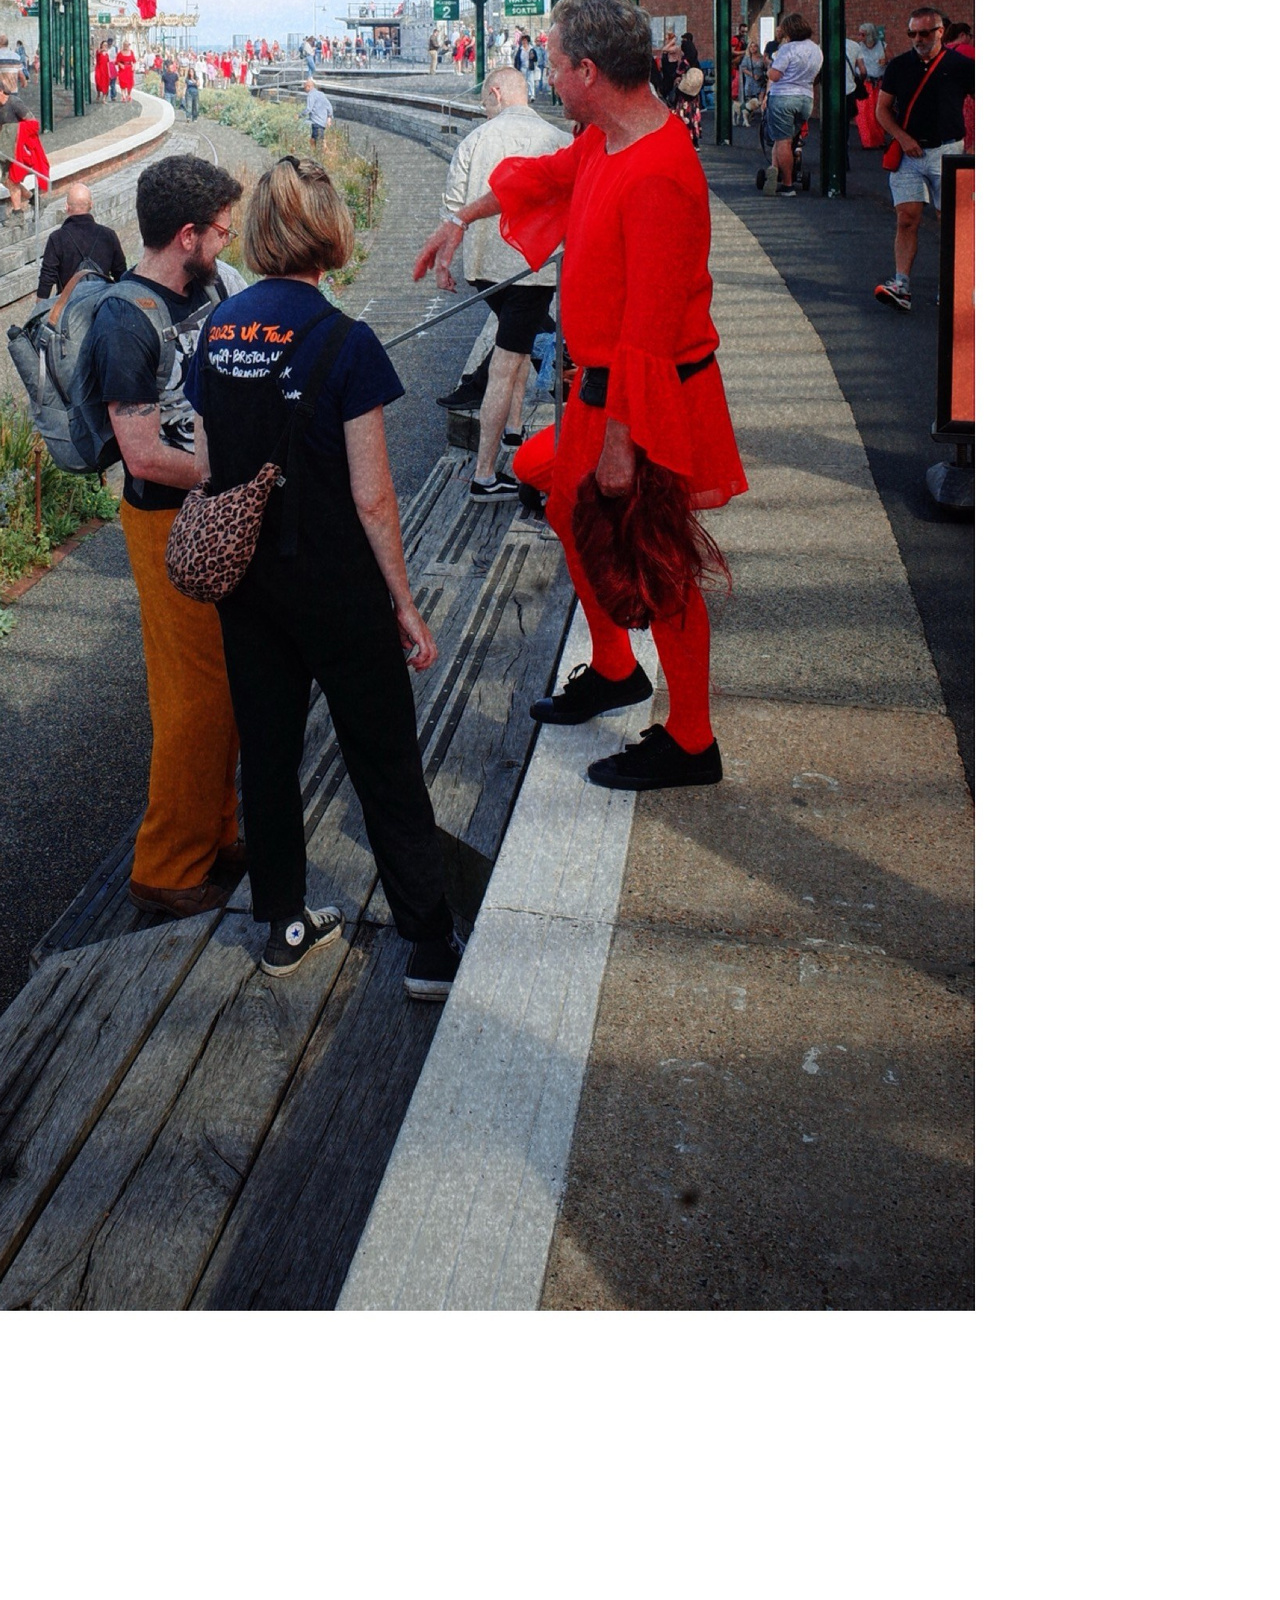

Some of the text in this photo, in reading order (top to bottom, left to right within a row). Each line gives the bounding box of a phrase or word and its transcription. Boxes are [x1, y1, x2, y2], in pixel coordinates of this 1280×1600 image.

[442, 6, 451, 19] 2
[511, 6, 538, 15] SORTIE
[208, 324, 236, 342] 2025
[240, 321, 261, 343] UK
[271, 350, 283, 362] U
